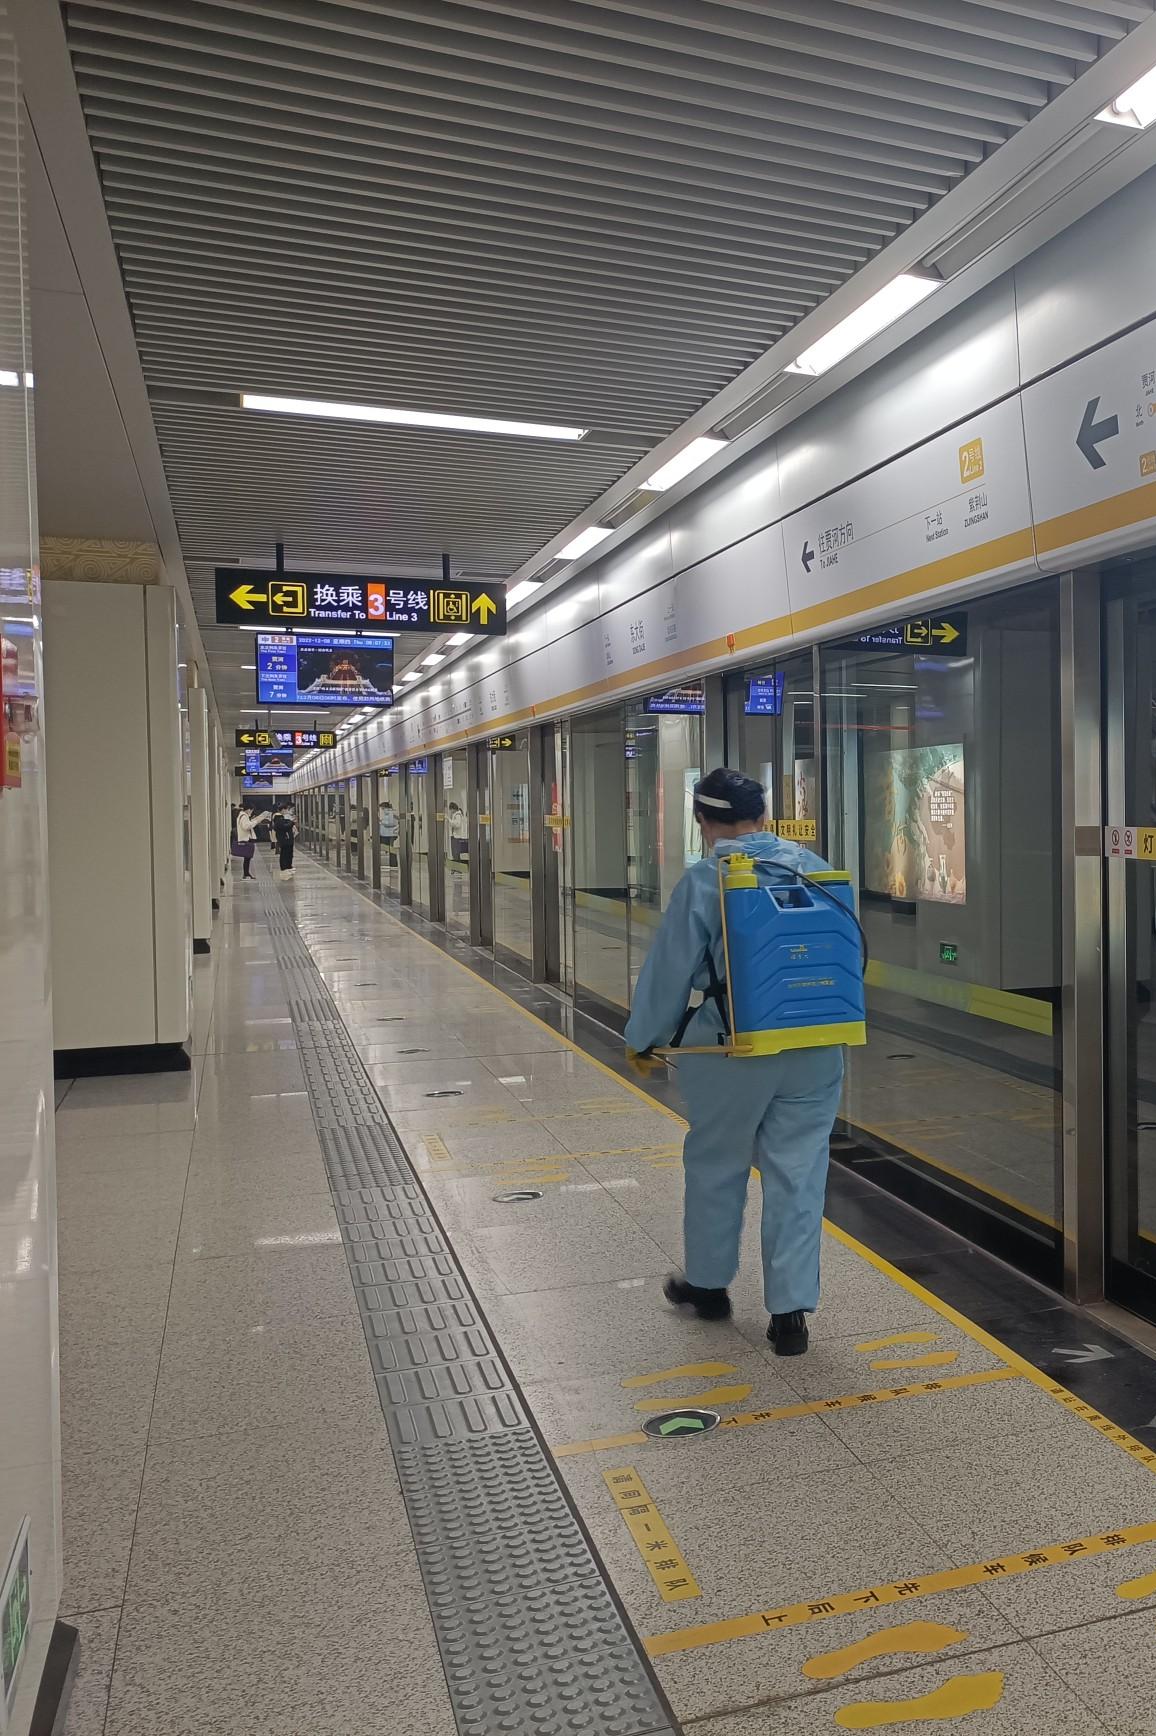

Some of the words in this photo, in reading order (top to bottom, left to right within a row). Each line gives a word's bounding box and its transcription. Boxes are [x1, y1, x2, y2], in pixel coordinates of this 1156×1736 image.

[1135, 403, 1143, 418] 北
[924, 510, 944, 531] 下一站
[817, 520, 855, 554] 往贾河方向
[309, 608, 352, 619] Transfer
[354, 610, 366, 620] To
[386, 611, 409, 622] Line
[411, 612, 418, 622] 3
[266, 662, 273, 670] 2
[982, 1533, 1128, 1578] 排队候车
[761, 1581, 922, 1627] 先下后上
